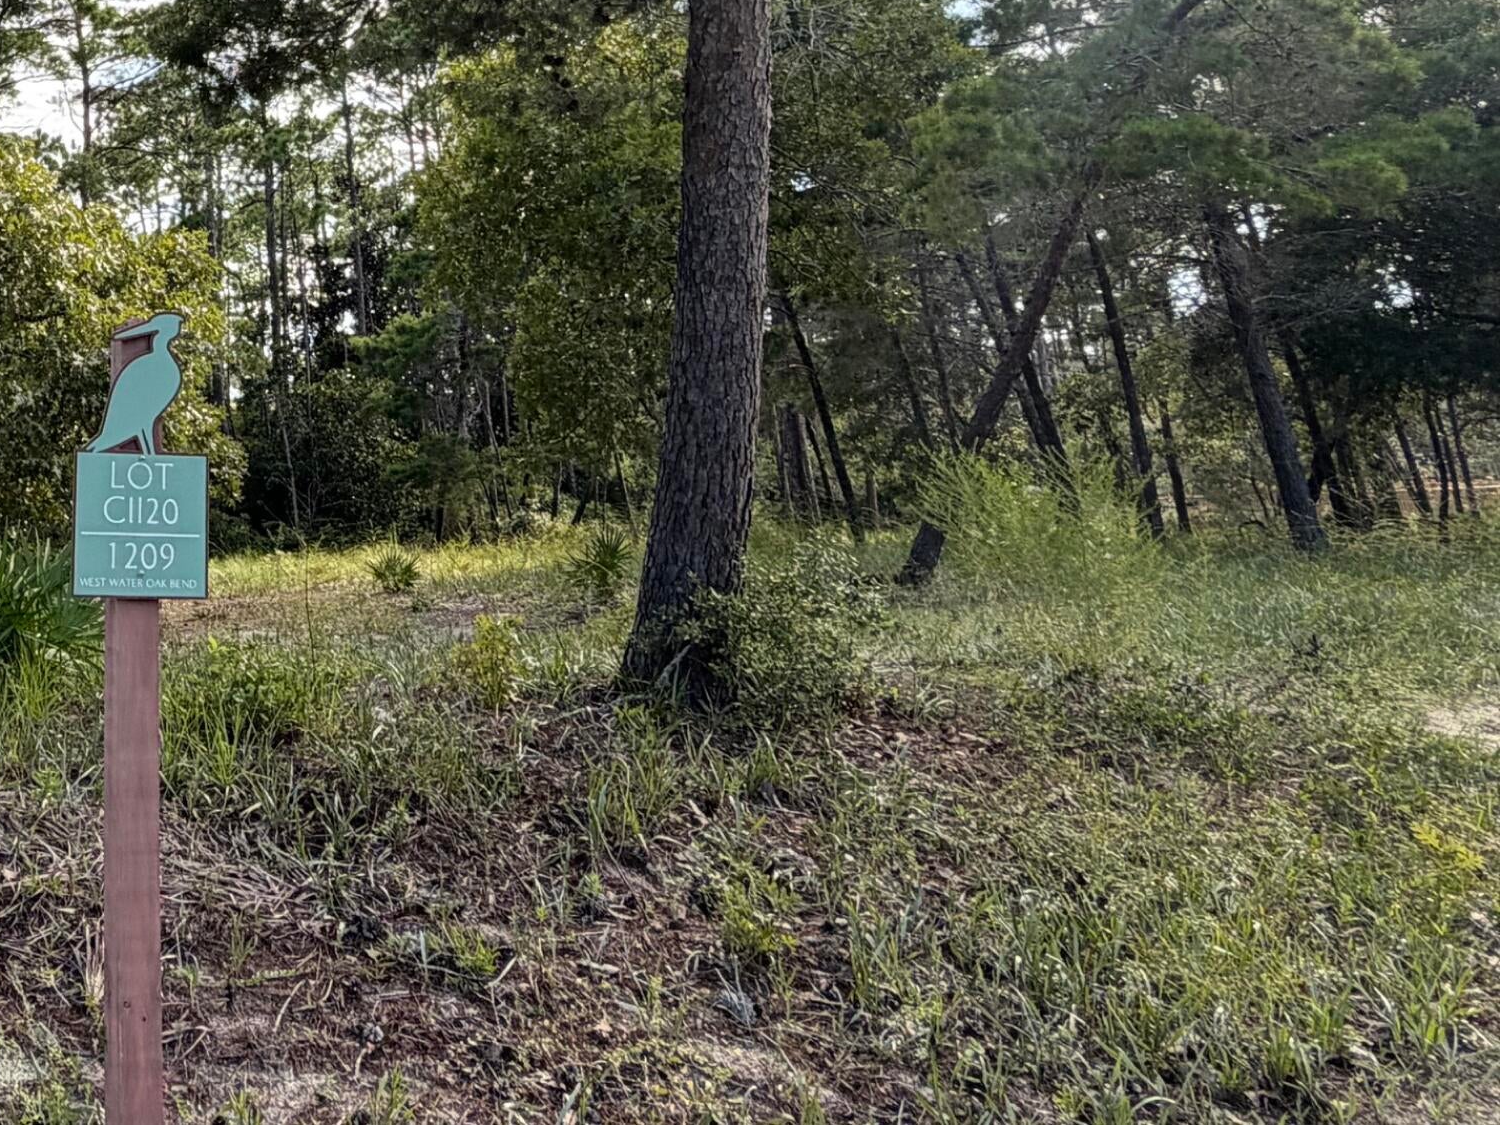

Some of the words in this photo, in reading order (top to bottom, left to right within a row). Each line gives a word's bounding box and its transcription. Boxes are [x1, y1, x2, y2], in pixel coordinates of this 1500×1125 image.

[110, 461, 174, 490] LOT
[108, 542, 175, 571] 1209
[79, 577, 107, 588] WEST
[108, 577, 143, 588] WATER
[145, 578, 167, 589] OAK
[169, 578, 197, 589] BEND
